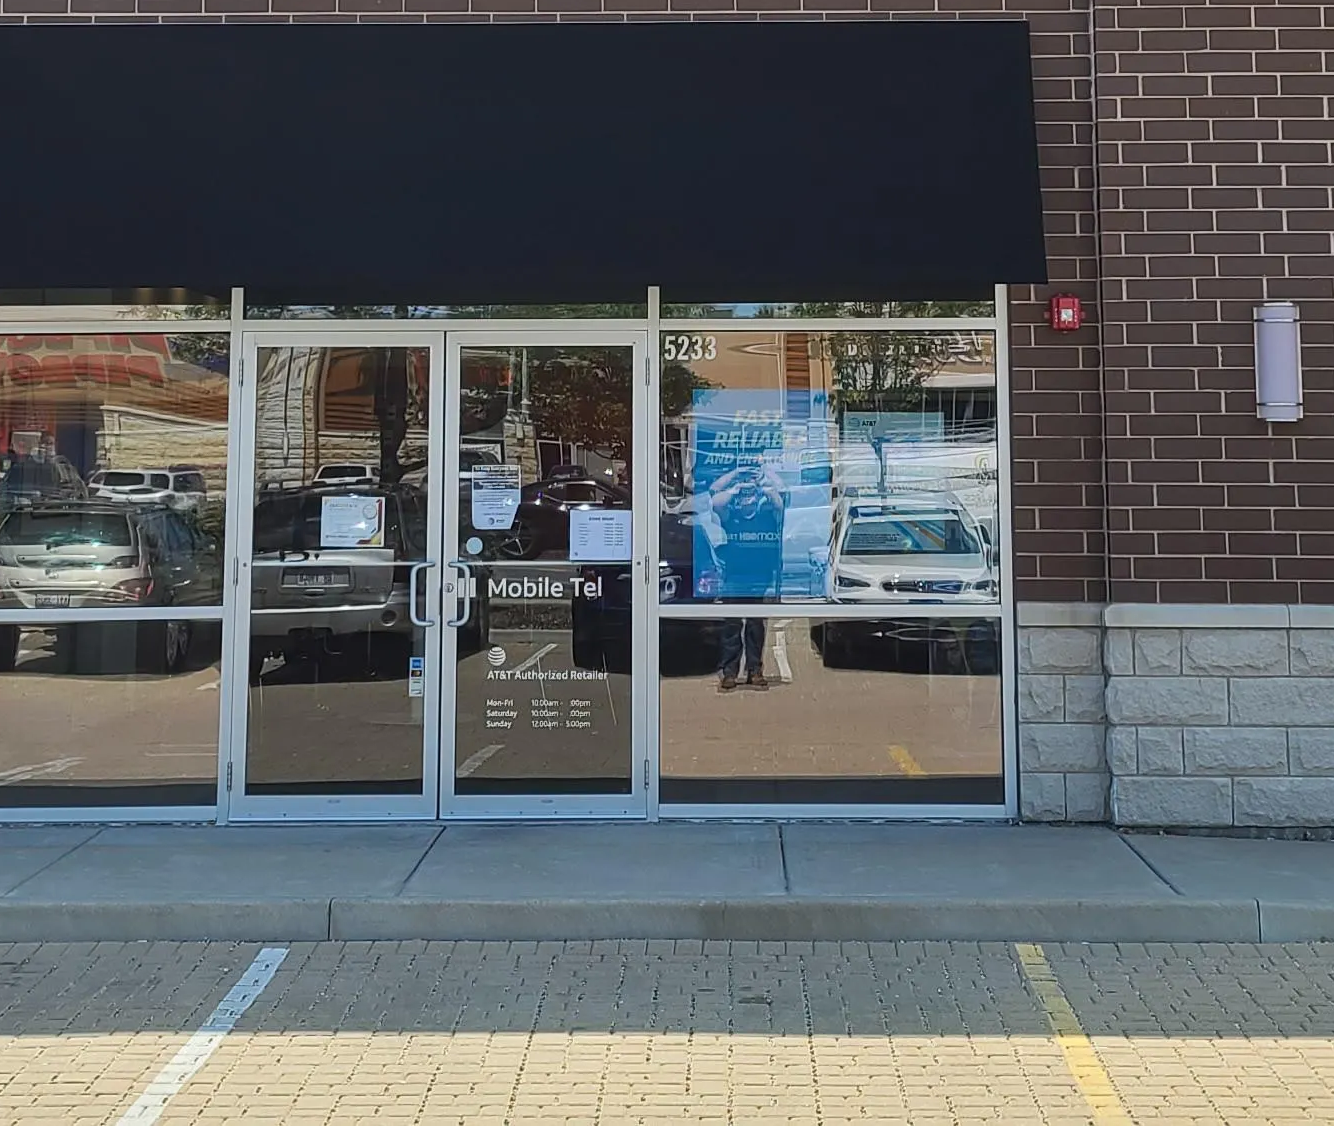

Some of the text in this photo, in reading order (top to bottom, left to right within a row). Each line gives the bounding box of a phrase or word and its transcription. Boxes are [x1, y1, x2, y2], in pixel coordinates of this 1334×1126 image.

[664, 335, 717, 361] 5233
[733, 409, 785, 427] FAST
[703, 453, 735, 465] AND
[488, 576, 603, 598] Mobile Tel
[487, 669, 608, 680] AT&T Authorized Retailer
[486, 710, 518, 719] Saturday
[486, 720, 512, 729] Sunday
